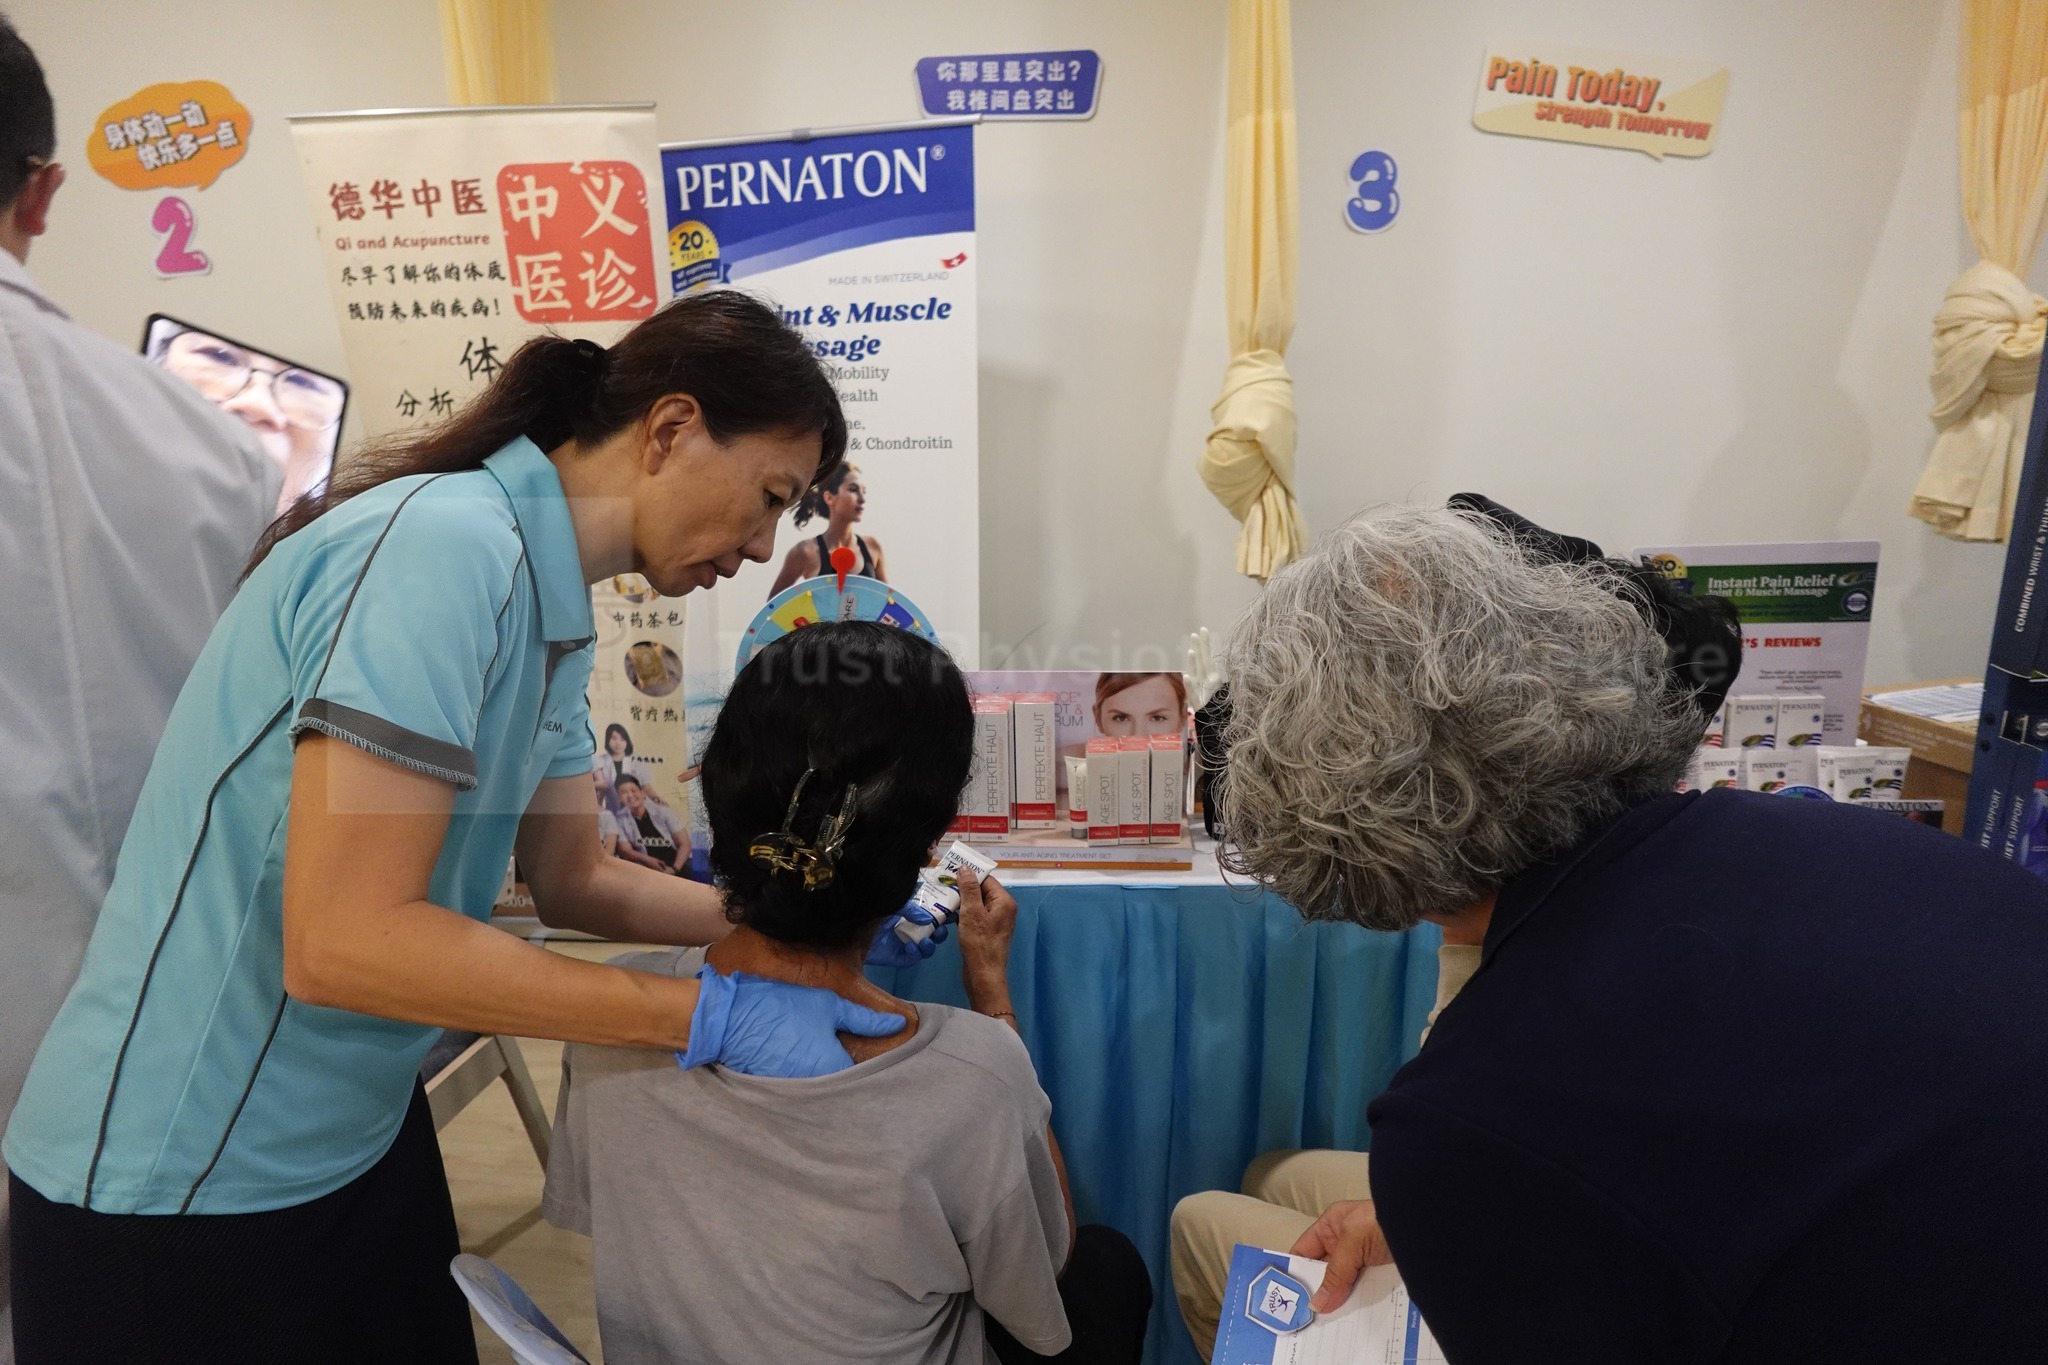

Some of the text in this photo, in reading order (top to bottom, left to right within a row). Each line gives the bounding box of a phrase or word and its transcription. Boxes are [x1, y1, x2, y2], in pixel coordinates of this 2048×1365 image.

[1487, 57, 1558, 98] Pain
[946, 88, 1075, 111] 我椎间盘突出
[104, 100, 208, 150] 身体动一动
[1535, 100, 1714, 141] Strength Tomorrow
[329, 178, 487, 221] 德华中医
[1346, 150, 1398, 230] 3
[152, 196, 209, 274] 2
[335, 234, 490, 251] Qi and Acupuncture
[678, 230, 704, 251] 20
[341, 260, 506, 287] 尽早了解你的体质
[829, 271, 950, 286] MADE IN SWITZERLAND
[778, 297, 953, 327] int & Muscle
[803, 335, 881, 361] sage
[829, 366, 890, 382] Mobility
[395, 388, 455, 417] 分析
[838, 389, 879, 403] ealth
[850, 436, 953, 451] & Chondroitin
[1708, 574, 1836, 589] Instant Pain Relief
[1745, 588, 1782, 597] Muscle
[1783, 588, 1829, 598] Massage
[2014, 578, 2036, 633] COMBINED
[2029, 546, 2044, 576] WRIST
[613, 610, 684, 628] 中药茶包
[1764, 637, 1822, 648] REVIEWS
[630, 705, 686, 724] 背疗热
[986, 723, 998, 813] PERFEKTE HAUT
[1034, 711, 1045, 800] PERFEKTE HAUT
[1100, 775, 1110, 824] AGE SPOT
[1132, 772, 1142, 822] AGE SPOT
[1164, 772, 1174, 821] AGE SPOT
[1984, 789, 2001, 833] SUPPORT
[2007, 795, 2024, 840] SUPPORT
[1268, 1285, 1281, 1314] TRUST
